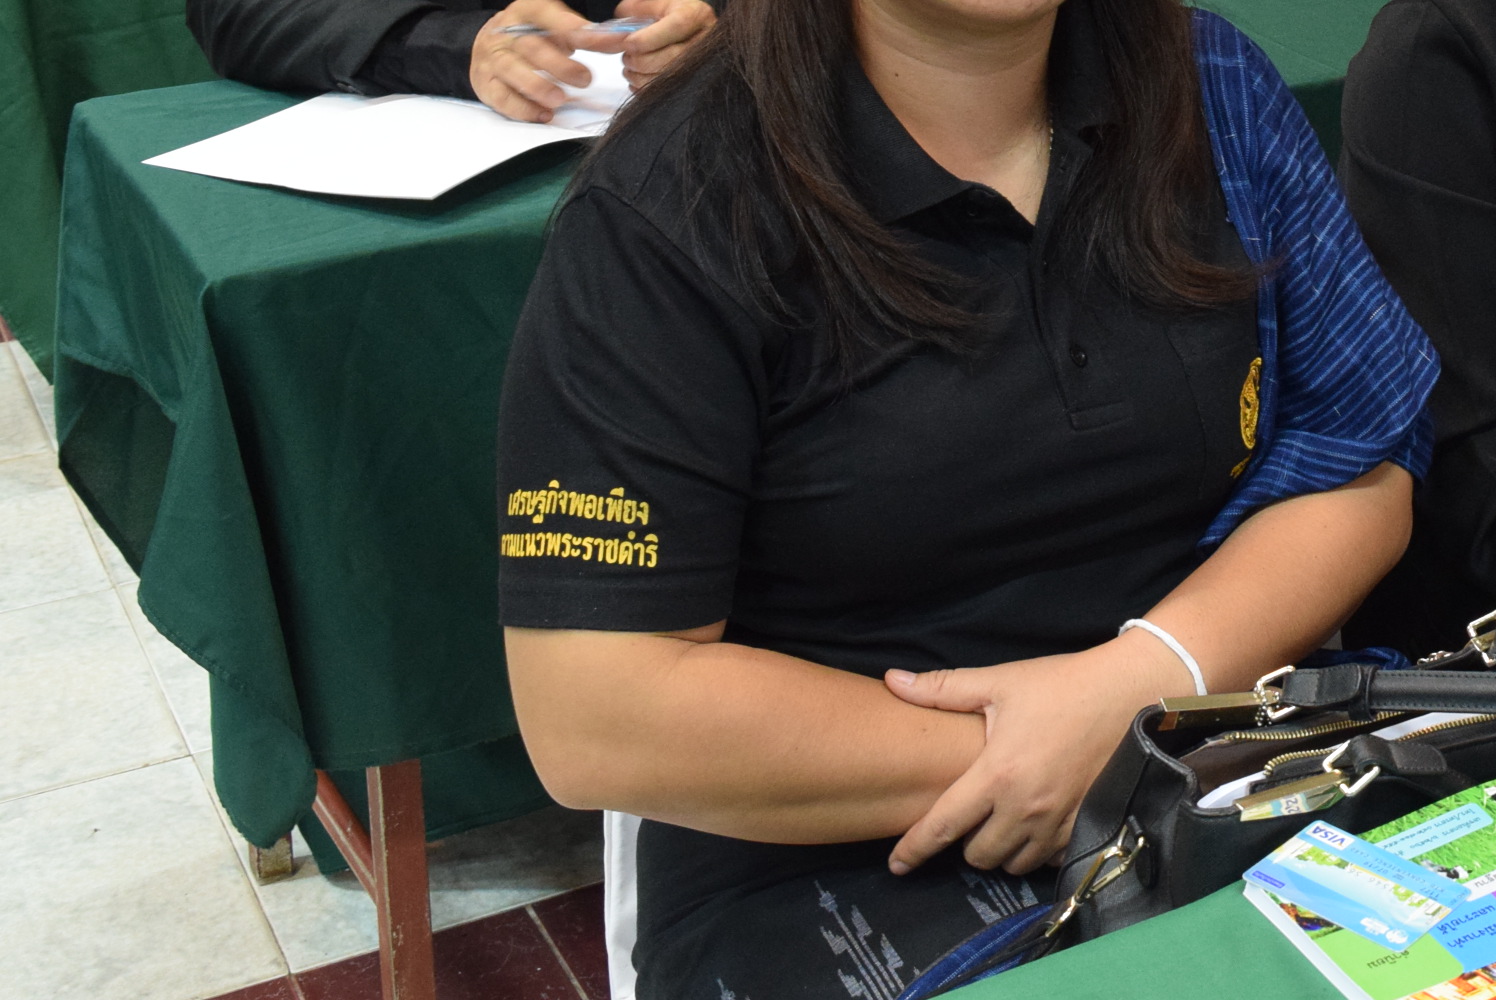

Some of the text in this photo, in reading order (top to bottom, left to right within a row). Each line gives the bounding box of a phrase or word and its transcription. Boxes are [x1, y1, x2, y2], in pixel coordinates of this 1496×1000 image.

[507, 479, 650, 525] เศรษฐกิจพอเพียง
[501, 531, 659, 568] ตามแนวพระราชดำริ
[1312, 825, 1346, 847] VISA
[1434, 904, 1496, 935] และรายได้
